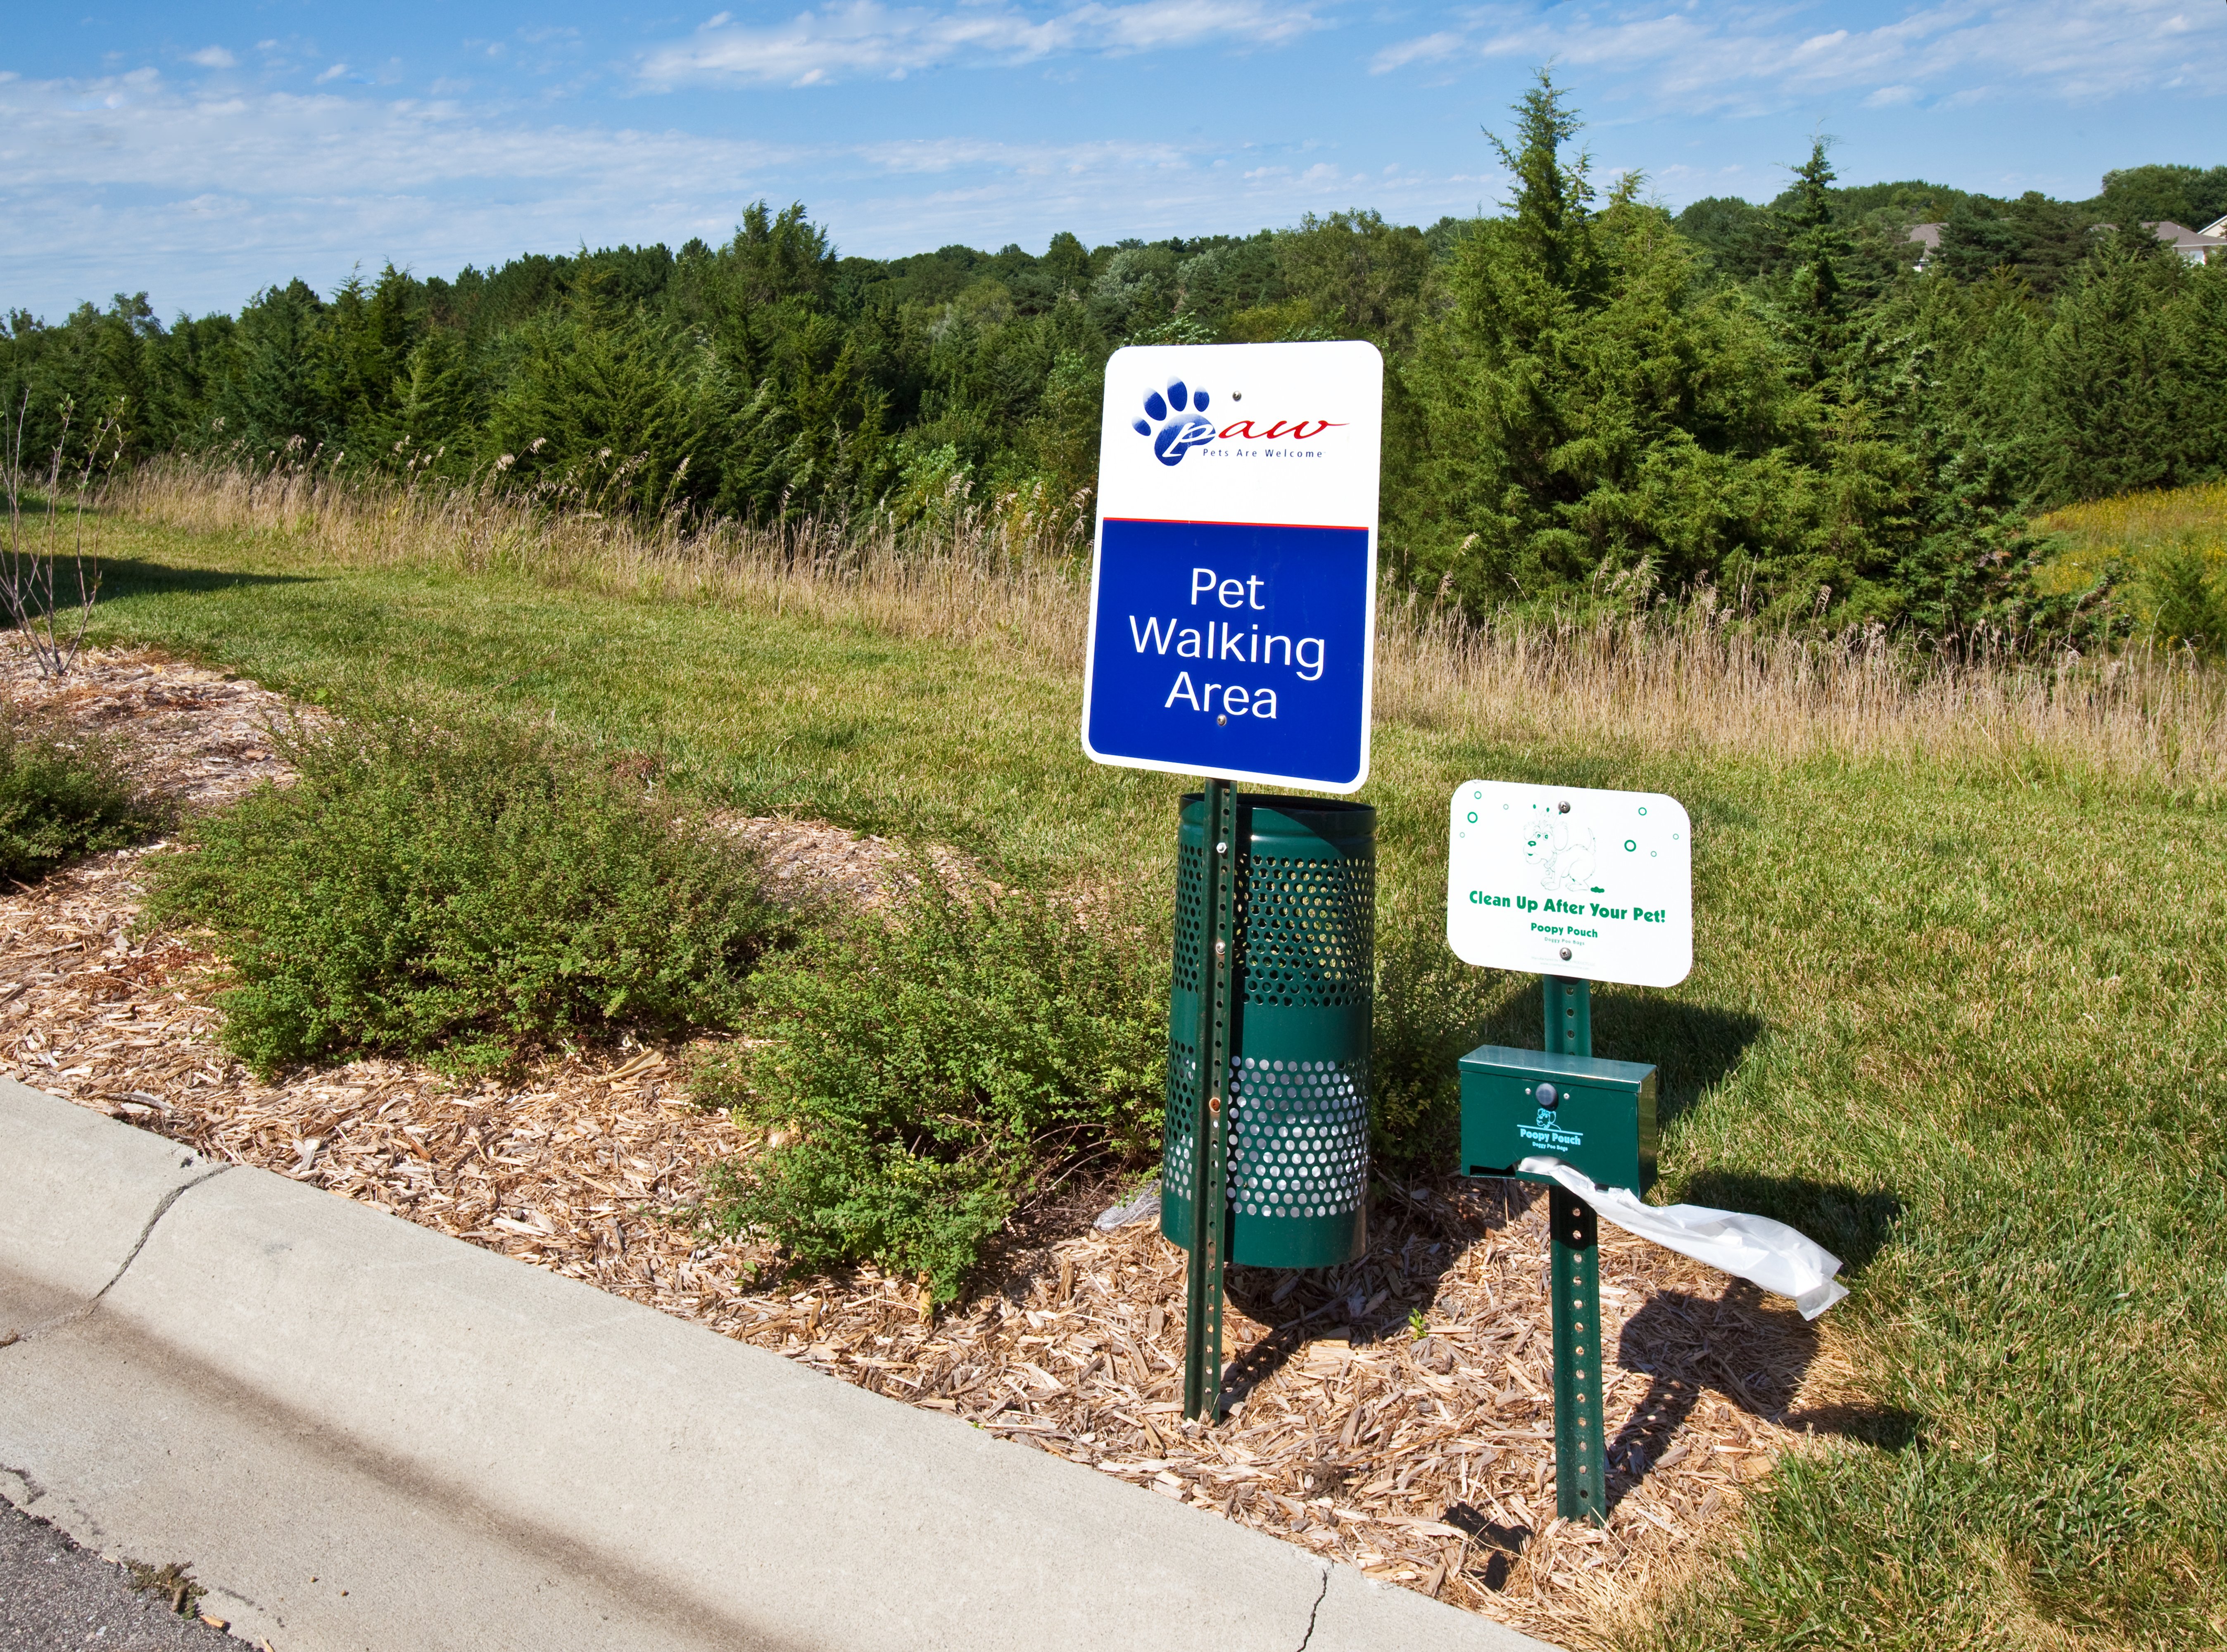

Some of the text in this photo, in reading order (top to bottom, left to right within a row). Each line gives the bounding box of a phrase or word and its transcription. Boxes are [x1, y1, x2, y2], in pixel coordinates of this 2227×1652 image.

[1162, 420, 1350, 457] paw
[1236, 449, 1257, 457] Are
[1265, 449, 1322, 458] Welcome
[1191, 568, 1265, 610] Pet
[1129, 615, 1324, 681] Walking
[1165, 672, 1276, 719] Area
[1469, 890, 1665, 923] Clean Up After Your Pet!
[1531, 923, 1598, 938] Poopy Pouch
[1520, 1128, 1581, 1145] Poopy Pouch
